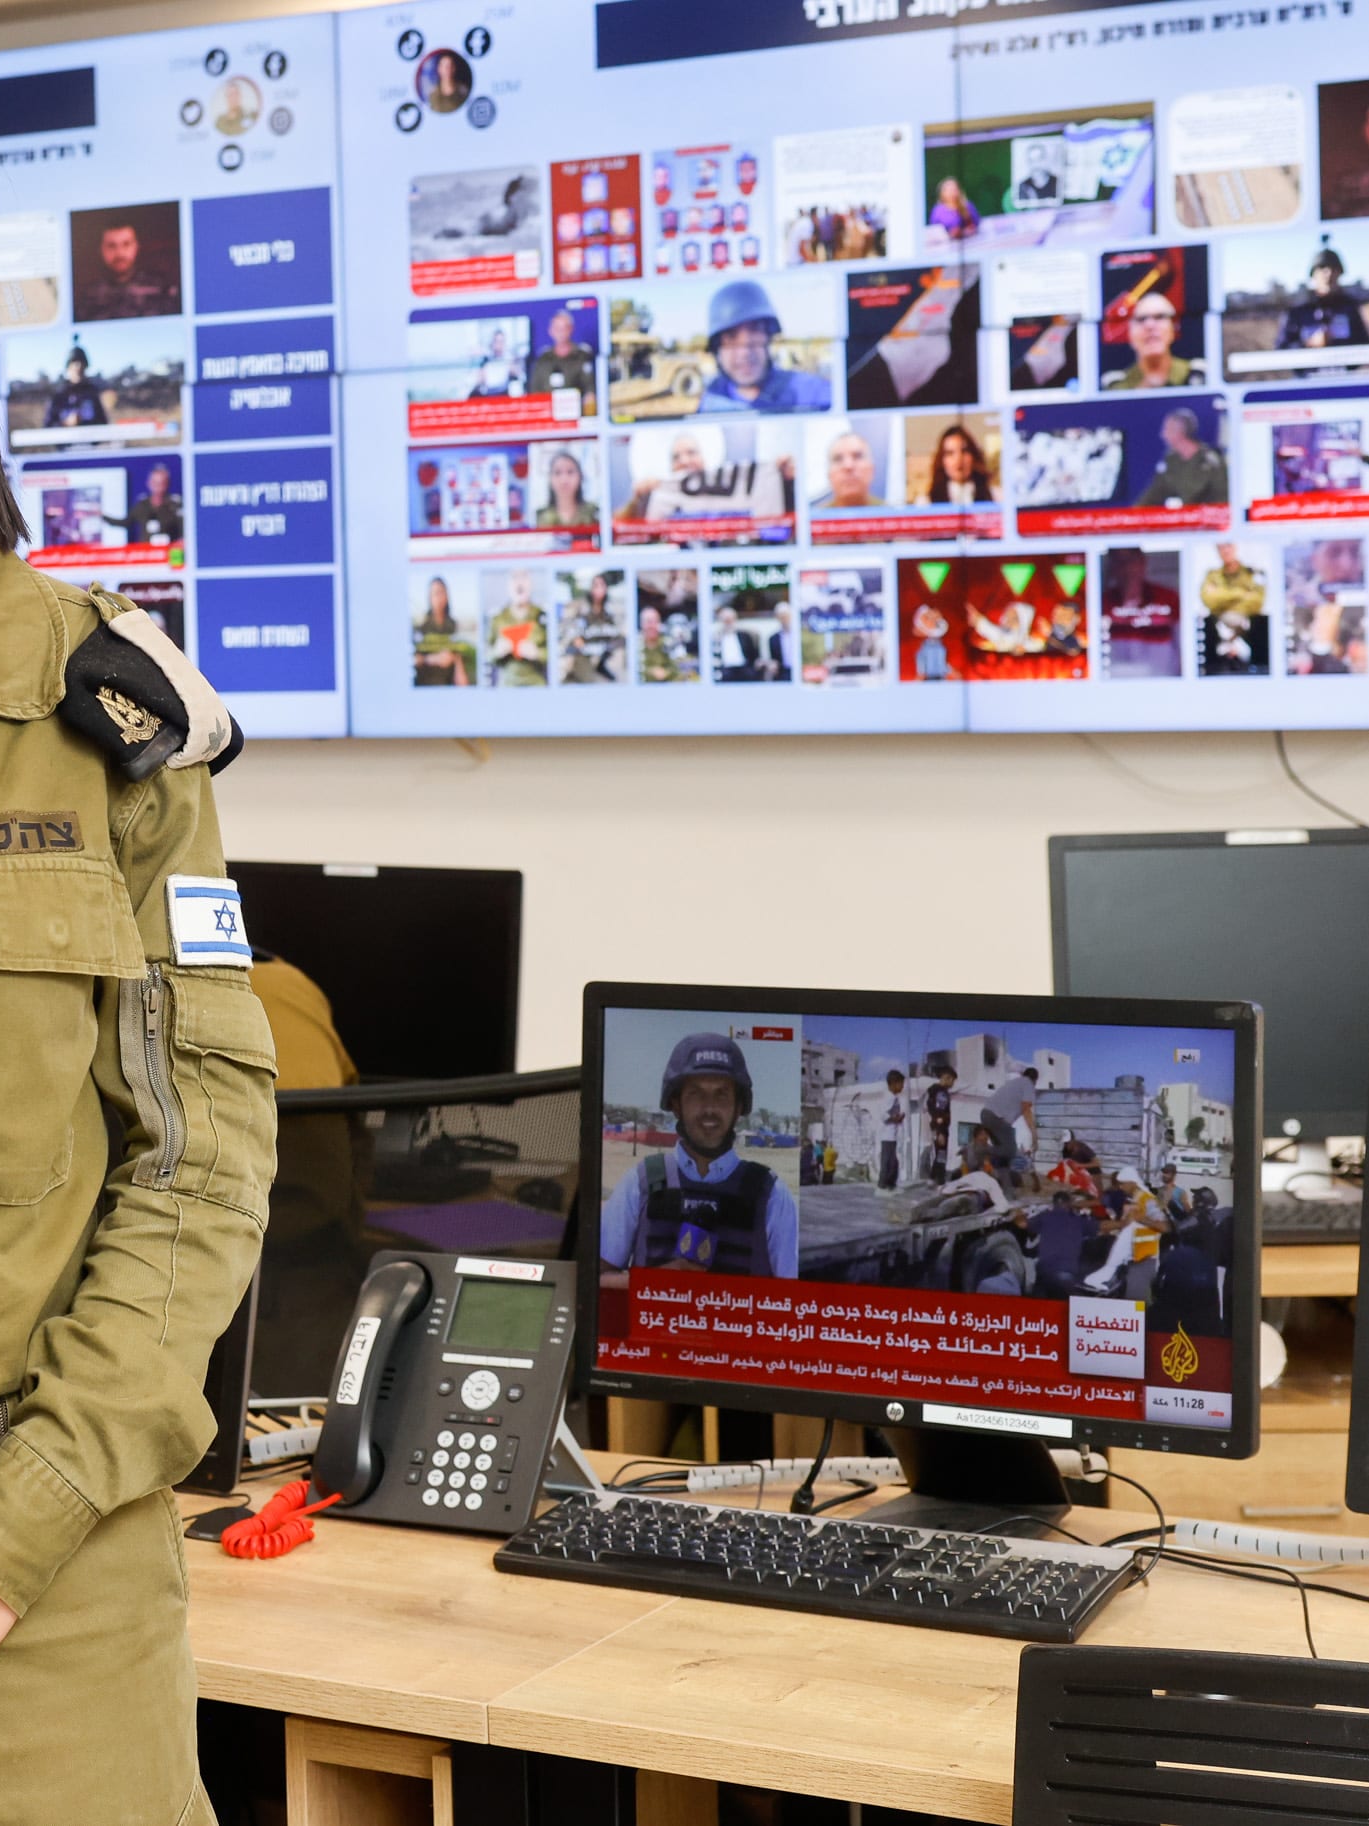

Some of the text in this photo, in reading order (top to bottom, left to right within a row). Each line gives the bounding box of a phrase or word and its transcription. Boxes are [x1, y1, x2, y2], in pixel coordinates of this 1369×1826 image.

[695, 1050, 729, 1064] PRESS
[637, 1286, 1059, 1336] مراسل الجزيرة: 6 شهداء وعدة جرحى في قصف إسرائيلي استهدف
[639, 1311, 664, 1326] غزة
[668, 1314, 708, 1333] قطاع
[713, 1318, 753, 1338] وسط
[756, 1321, 814, 1342] الزوايدة
[1075, 1315, 1139, 1334] التغطية
[819, 1326, 881, 1350] بمنطقة
[885, 1331, 931, 1354] جوادة
[611, 1342, 650, 1359] الجيش
[1076, 1339, 1138, 1357] مستمرة
[677, 1350, 1135, 1403] الاحتلال ارتكب مجزرة في قصف مدرسة إيواء تابعة للأونروا في مخيم النصيرات
[1173, 1396, 1205, 1410] 11:28
[956, 1411, 1040, 1431] Aa123456123456
